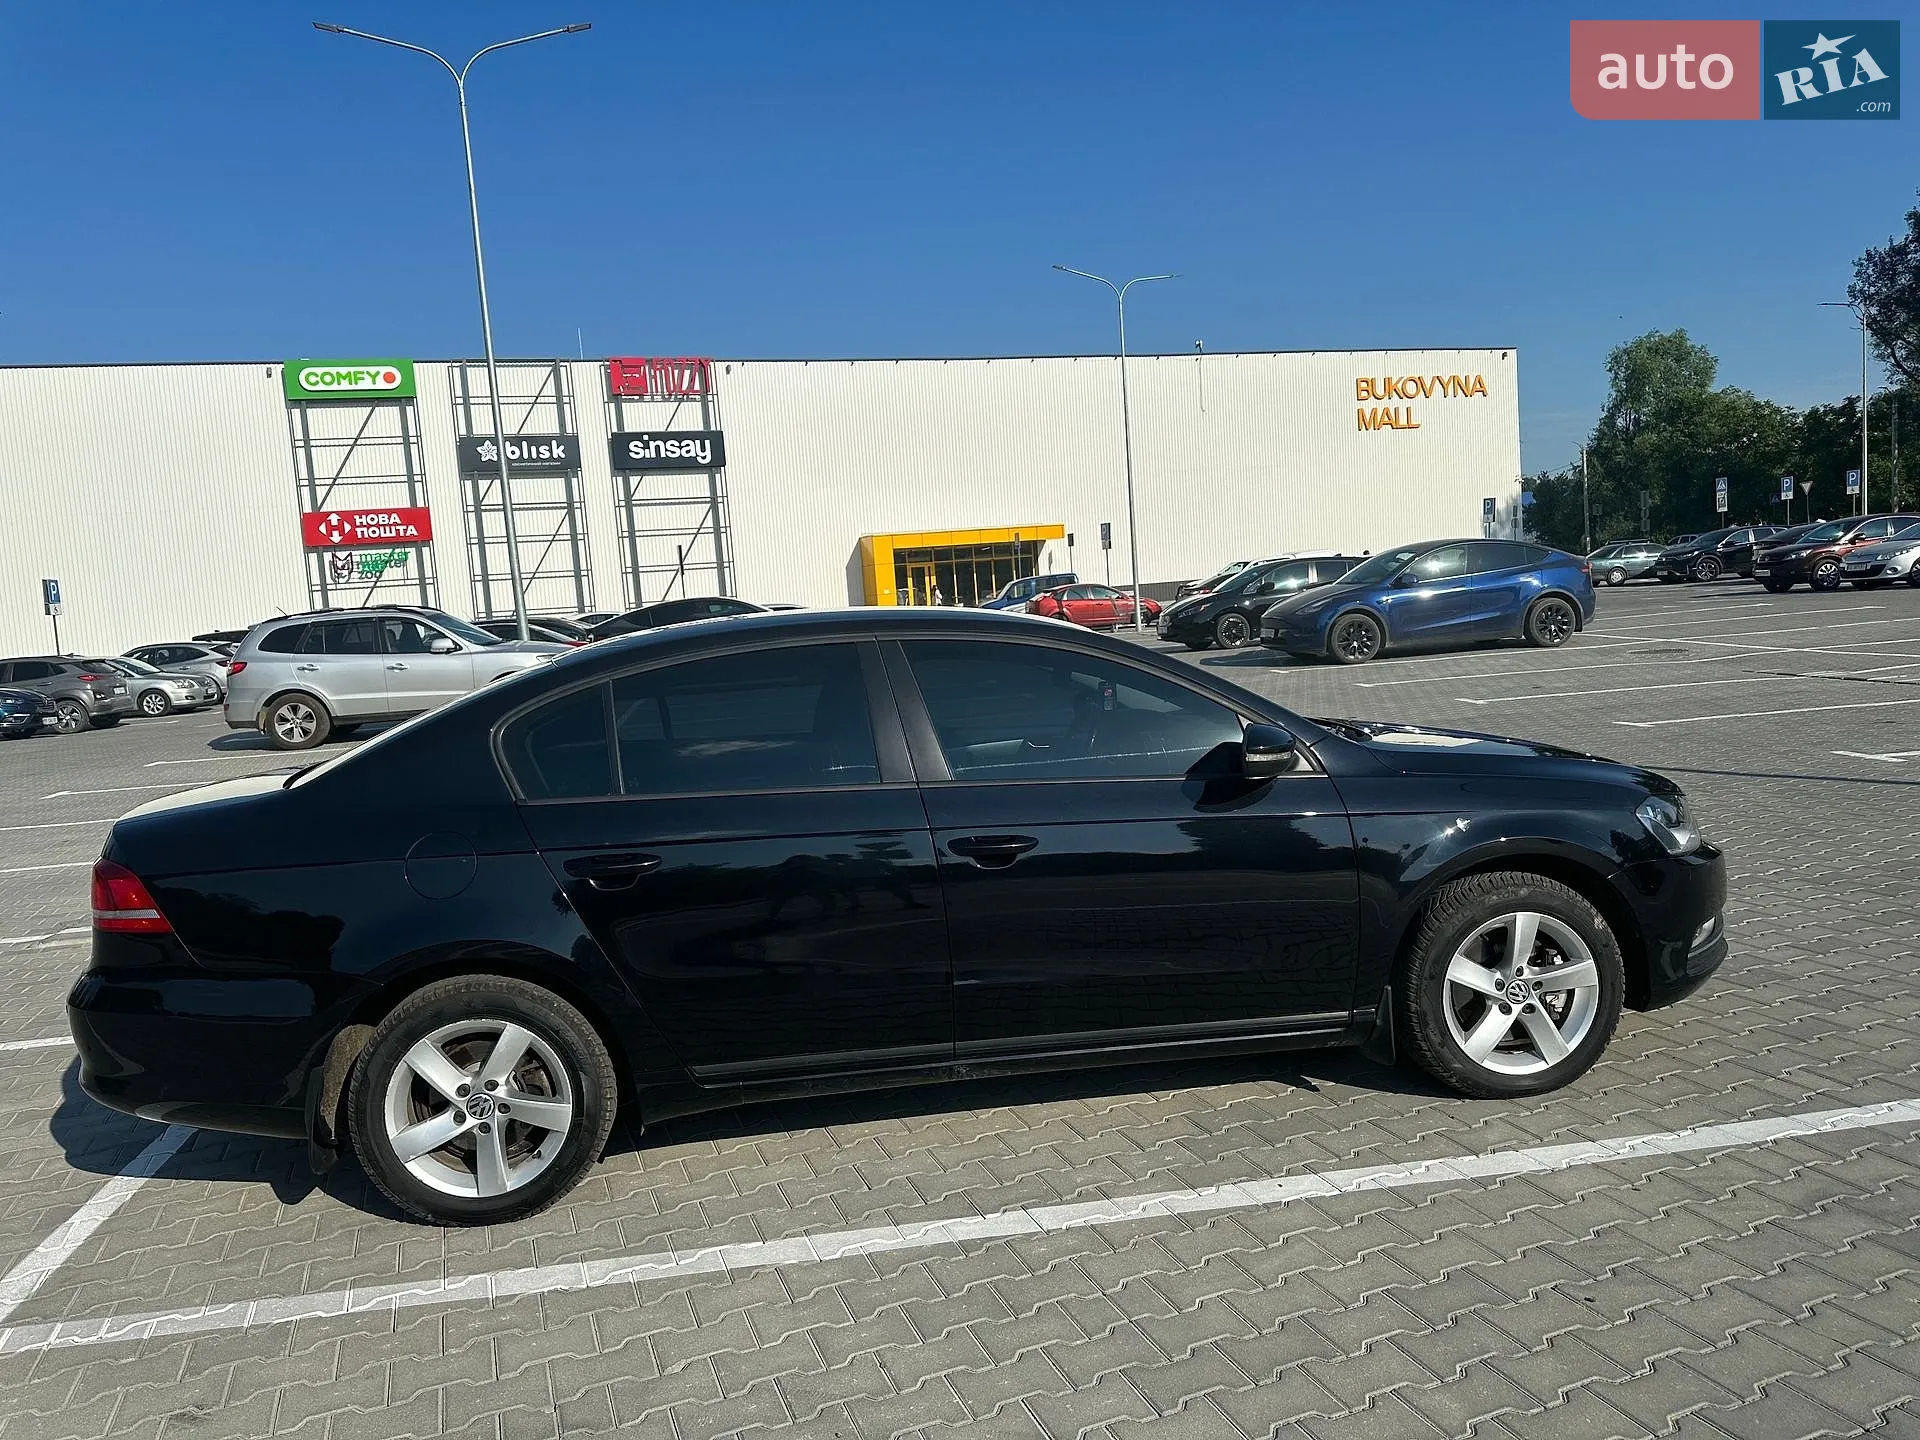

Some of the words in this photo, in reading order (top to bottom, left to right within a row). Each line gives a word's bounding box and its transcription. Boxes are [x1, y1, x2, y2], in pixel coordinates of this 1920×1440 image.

[304, 370, 381, 387] COMFY
[1356, 375, 1488, 401] BUKOVYNA
[1357, 407, 1421, 431] MALL
[504, 439, 566, 460] blisk
[628, 434, 712, 465] sinsay
[353, 512, 402, 527] НОВА
[355, 525, 419, 539] ПОШТА
